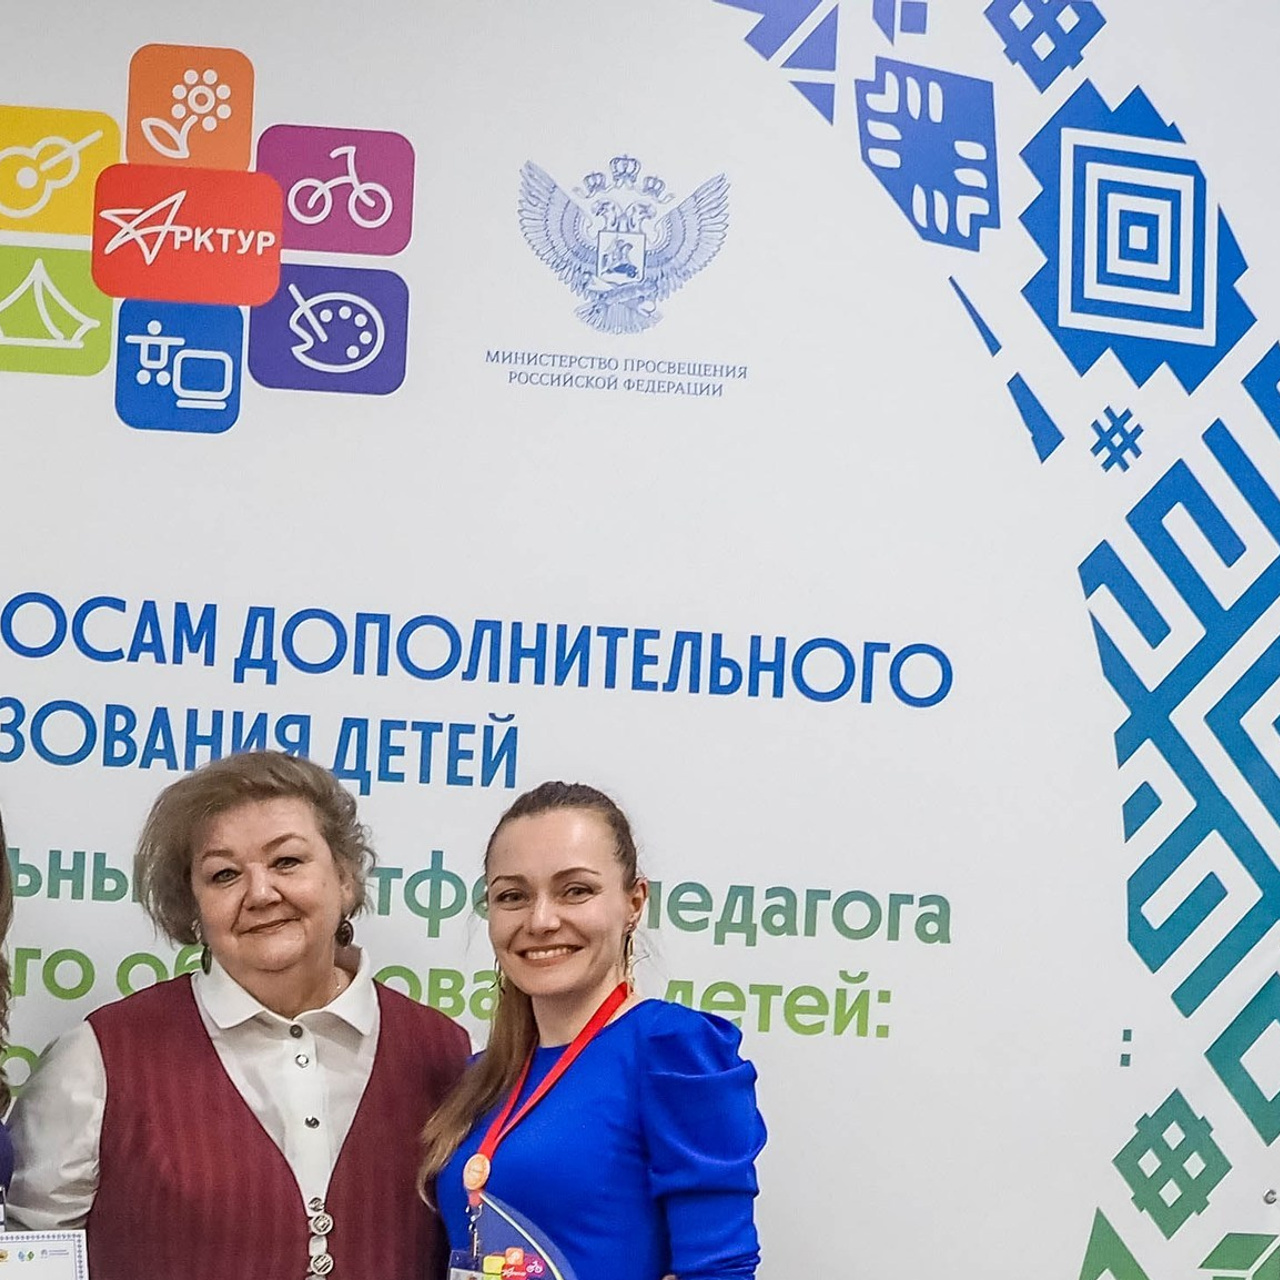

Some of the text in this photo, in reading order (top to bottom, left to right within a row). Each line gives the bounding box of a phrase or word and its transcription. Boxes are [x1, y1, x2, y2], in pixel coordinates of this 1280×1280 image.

[485, 350, 748, 379] МИНИСТЕРСТВО ПРОСВЕЩЕНИЯ
[508, 371, 724, 397] РОССИЙСКОЙ ФЕДЕРАЦИИ
[232, 606, 954, 709] ДОПОЛНИТЕЛЬНОГО
[332, 713, 519, 796] ДЕТЕЙ
